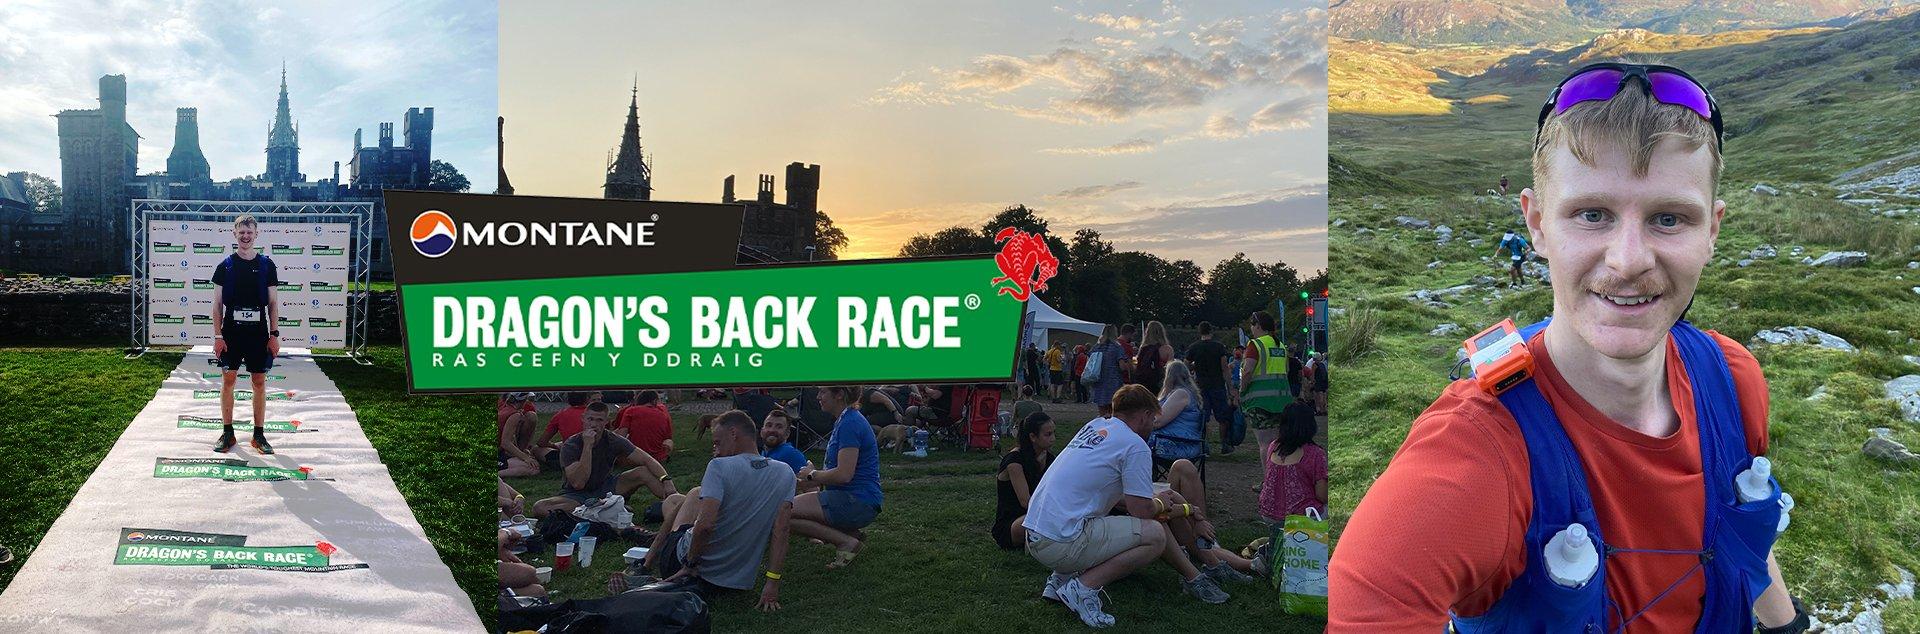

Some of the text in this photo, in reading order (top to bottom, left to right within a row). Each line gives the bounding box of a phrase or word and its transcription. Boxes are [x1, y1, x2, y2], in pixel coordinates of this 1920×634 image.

[161, 465, 220, 475] DRAGON'S
[224, 468, 257, 478] BACK
[146, 533, 215, 544] MONTANE
[125, 545, 208, 560] DRAGON'S
[213, 549, 257, 561] BACK
